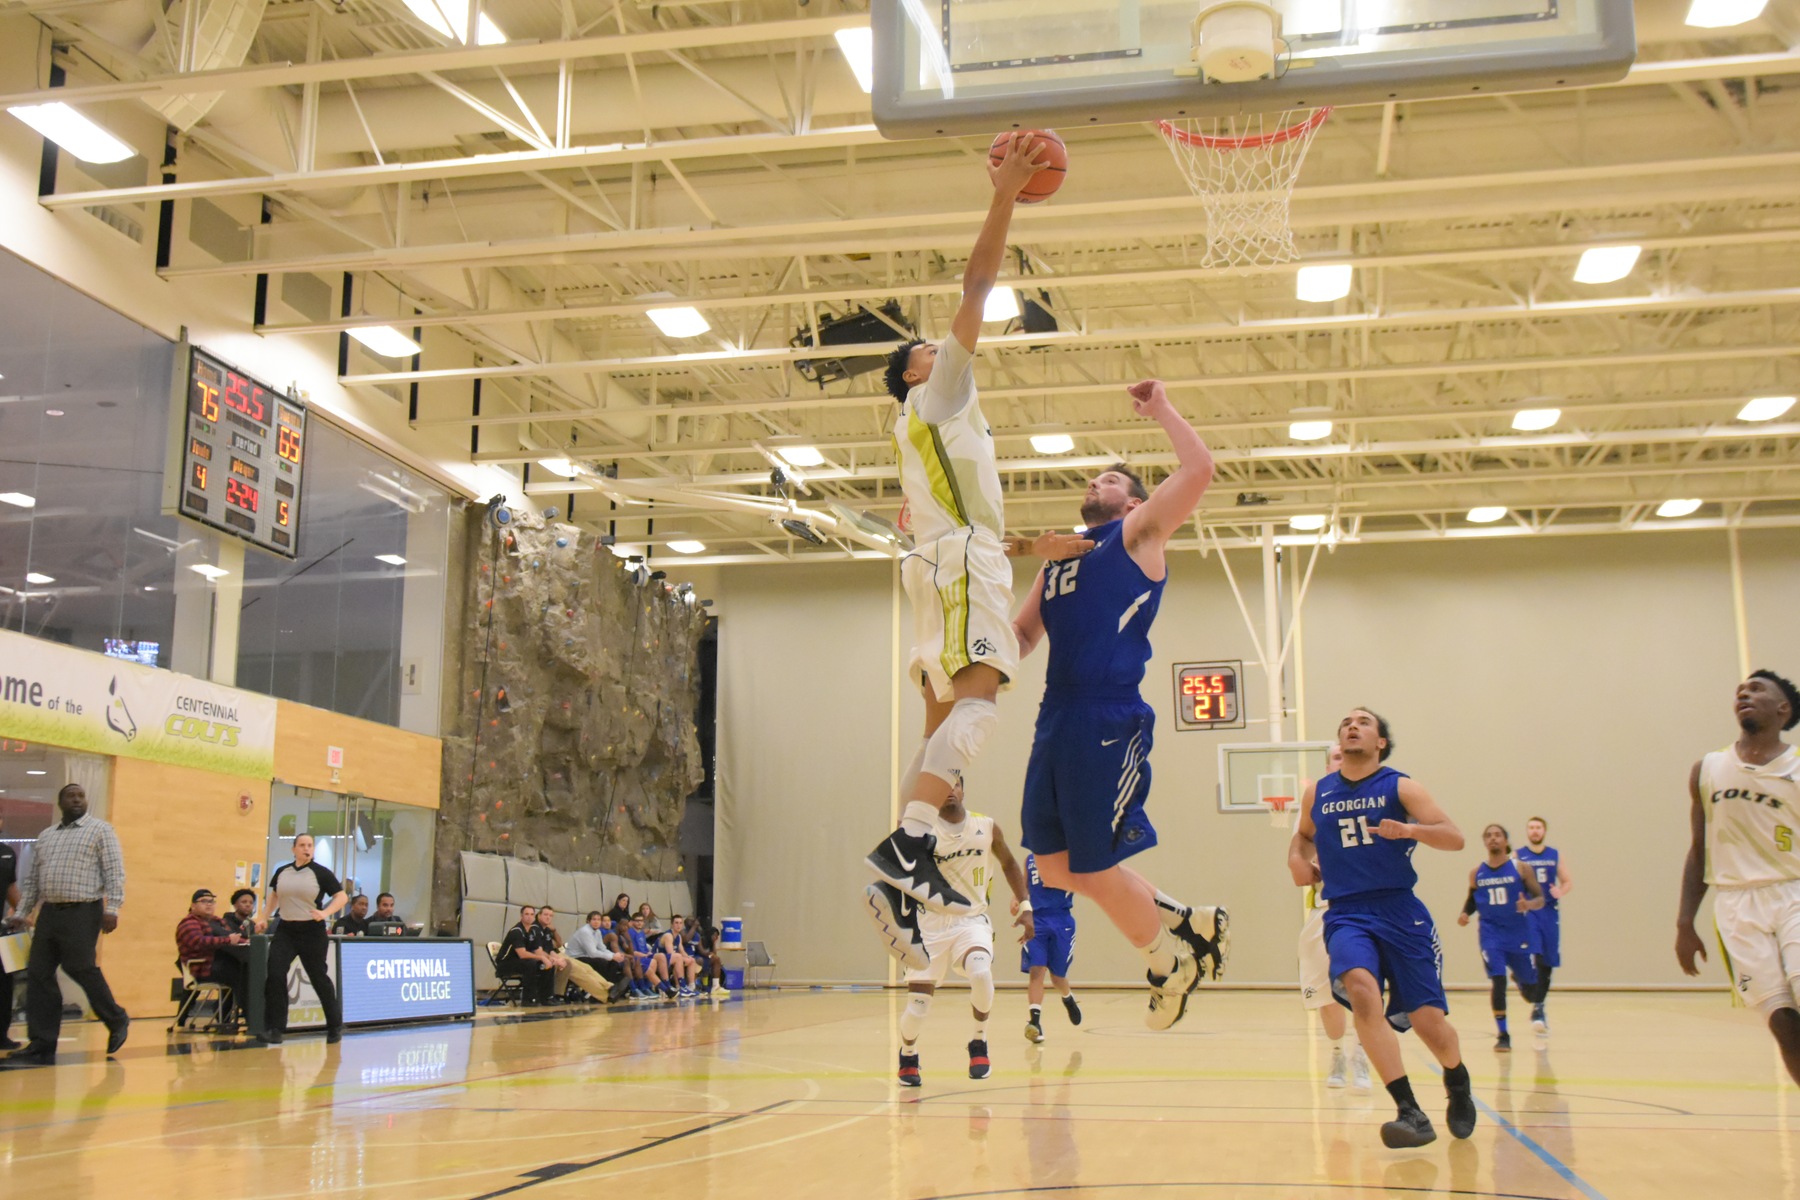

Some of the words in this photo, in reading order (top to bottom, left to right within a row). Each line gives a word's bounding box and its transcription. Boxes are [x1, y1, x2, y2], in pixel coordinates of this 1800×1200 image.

[197, 381, 219, 423] 75
[225, 371, 264, 421] 25.5
[279, 425, 300, 465] 65
[196, 465, 207, 490] 4
[280, 501, 289, 526] 5
[1045, 559, 1081, 601] 32
[0, 675, 43, 707] me
[48, 696, 60, 711] of
[65, 699, 83, 715] the
[1182, 675, 1225, 695] 25.5
[176, 695, 239, 722] CENTENNIAL
[1194, 694, 1226, 720] 21
[165, 713, 242, 747] COLTS
[1321, 795, 1387, 815] GEORGIAN
[1711, 788, 1783, 809] COLTS
[1338, 815, 1374, 848] 21
[1774, 825, 1794, 852] 5
[972, 866, 984, 887] 11
[1487, 886, 1507, 905] 10
[366, 958, 450, 980] CENTENNIAL
[401, 980, 451, 1002] COLLEGE
